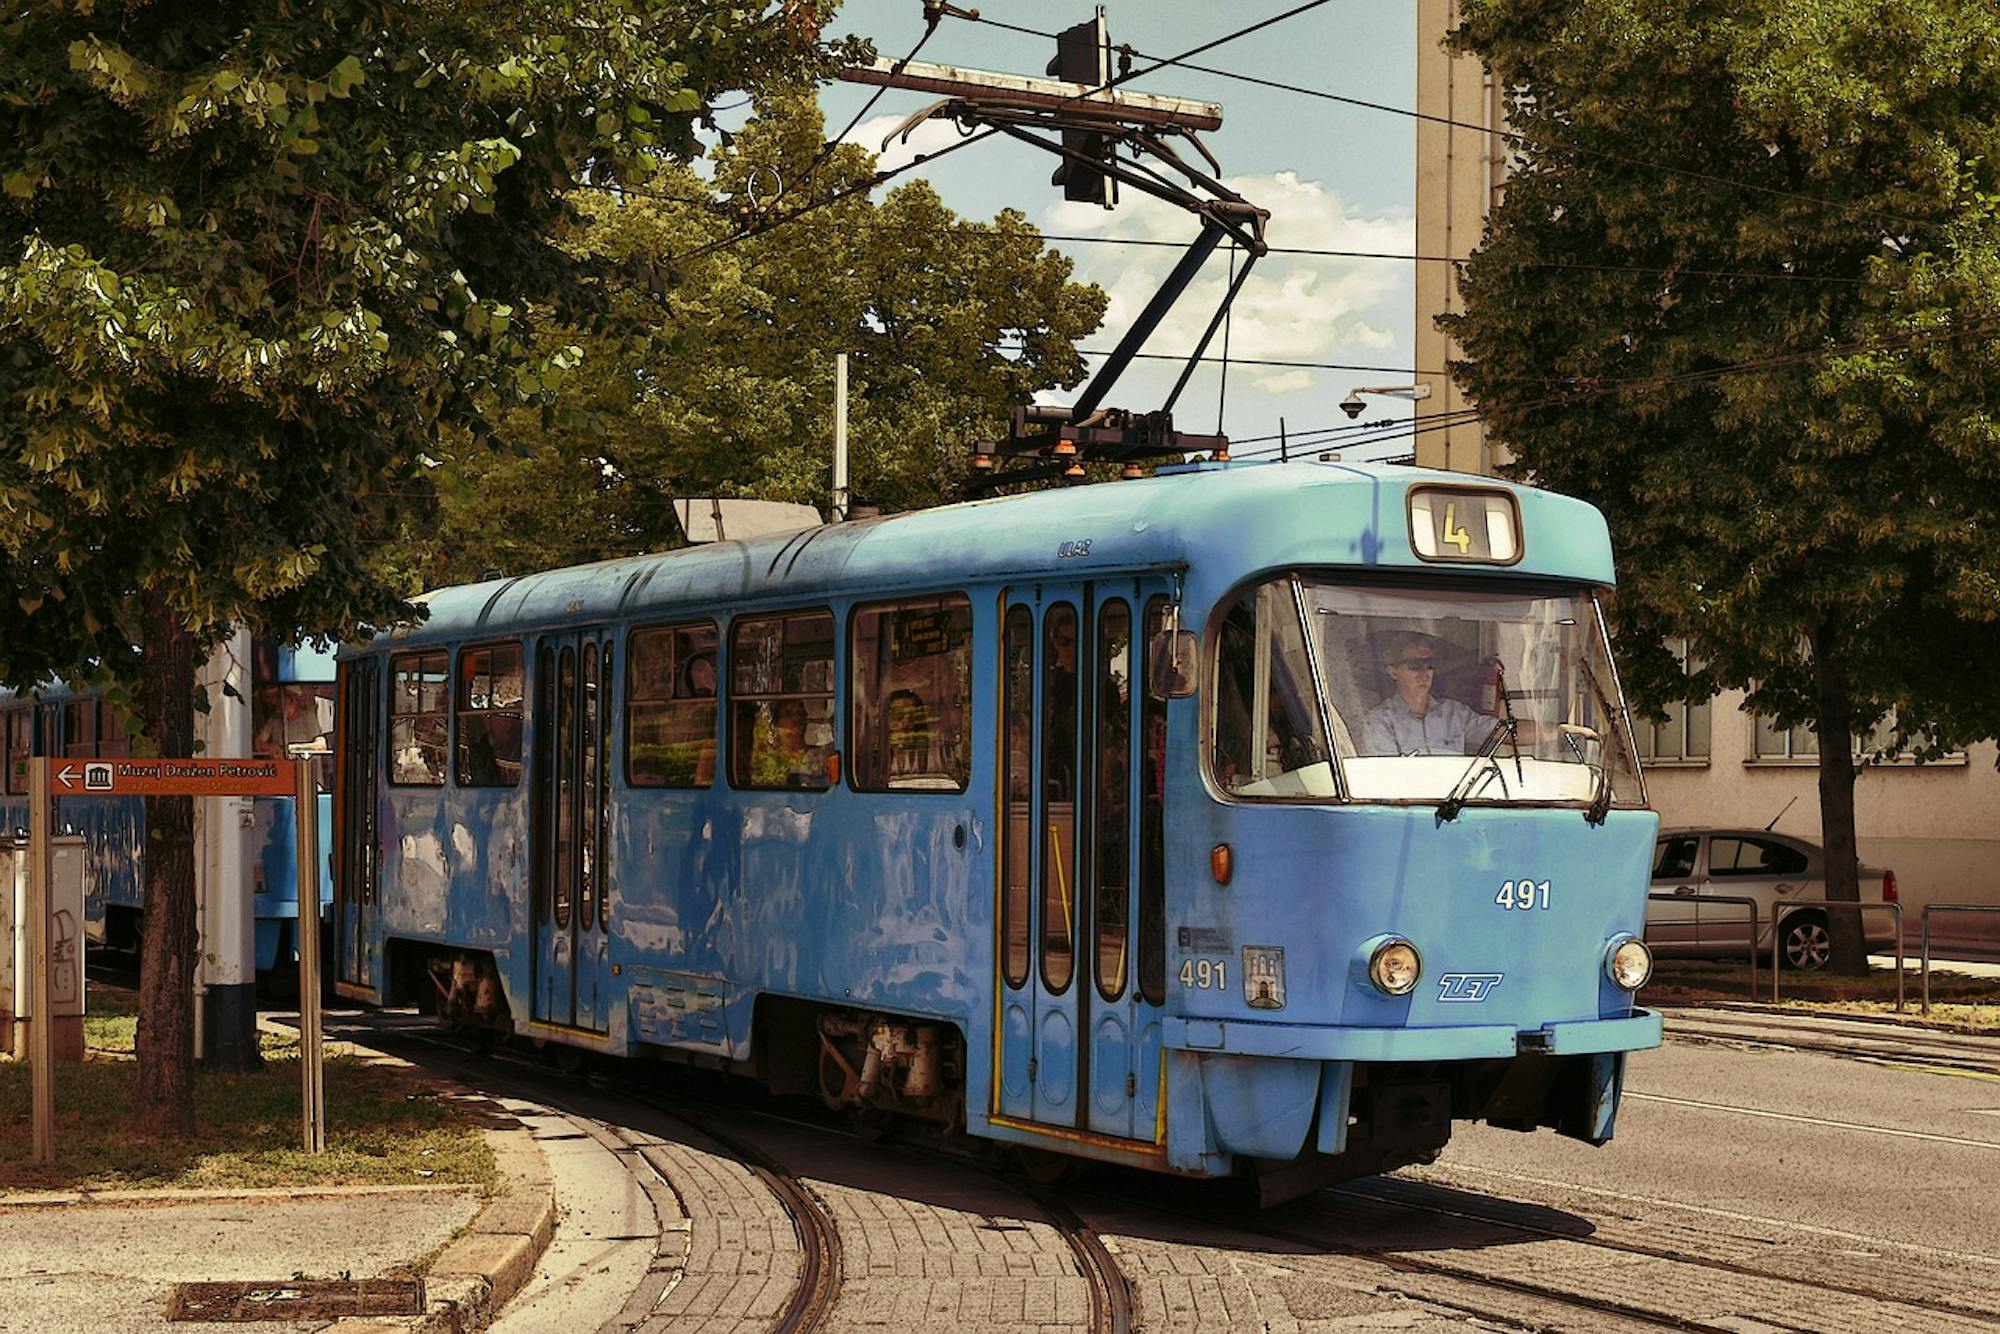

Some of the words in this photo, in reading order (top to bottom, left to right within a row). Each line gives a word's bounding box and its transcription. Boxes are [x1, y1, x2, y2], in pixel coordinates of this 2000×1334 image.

[1443, 502, 1470, 554] 4
[118, 763, 161, 780] Muzej
[166, 762, 216, 777] Dražen
[219, 763, 277, 777] Petrović
[1495, 879, 1551, 910] 491
[1178, 958, 1226, 990] 491
[1437, 973, 1504, 1003] ZET
